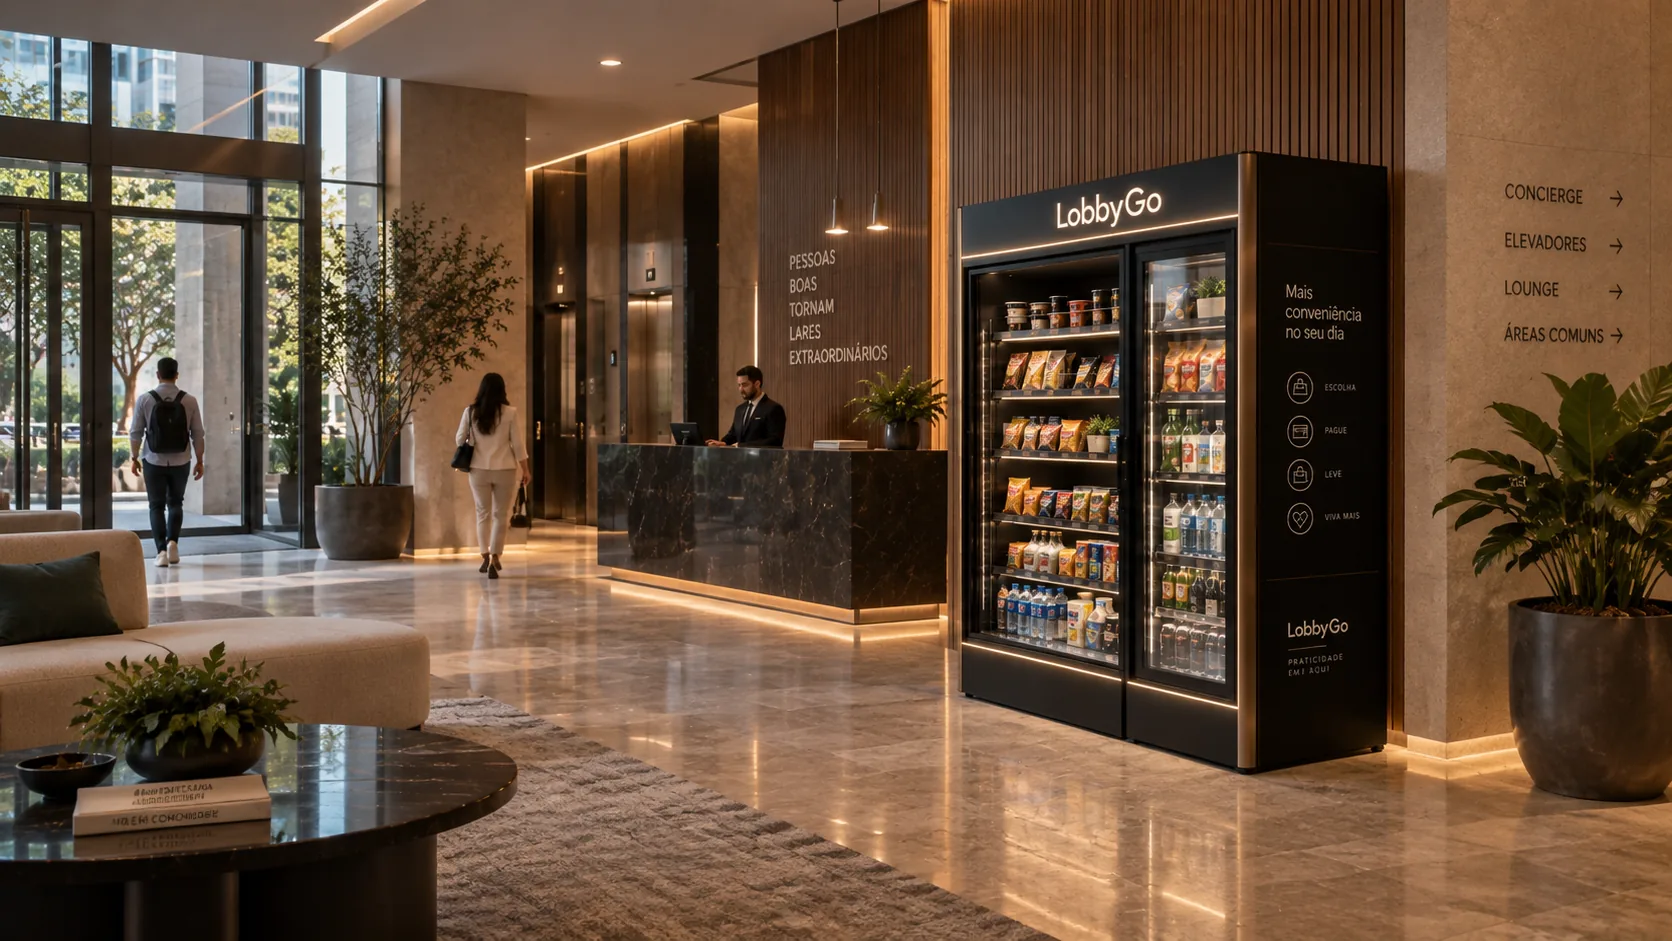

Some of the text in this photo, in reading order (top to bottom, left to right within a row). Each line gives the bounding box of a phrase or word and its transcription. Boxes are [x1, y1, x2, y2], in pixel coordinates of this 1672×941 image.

[1504, 183, 1583, 204] CONCIERGE
[1056, 187, 1162, 229] LobbyGo
[1504, 232, 1587, 252] ELEVADORES
[789, 249, 836, 270] PESSOAS
[789, 276, 818, 293] BOAS
[1285, 284, 1313, 300] Mais
[1504, 280, 1559, 297] LOUNGE
[789, 298, 835, 317] TORNAM
[1285, 305, 1362, 322] conveniência
[789, 324, 822, 341] LARES
[1285, 325, 1345, 340] no seu dia
[1503, 321, 1604, 343] ÁREAS COMUNS
[789, 342, 888, 365] EXTRAORDINÁRIOS
[1324, 383, 1356, 392] ESCOLHA
[1324, 426, 1347, 435] PAGUE
[1324, 470, 1342, 478] LEVE
[1324, 511, 1360, 521] VIVA MAIS
[1287, 618, 1349, 639] LobbyGo
[1288, 653, 1343, 666] PRATICIDADE
